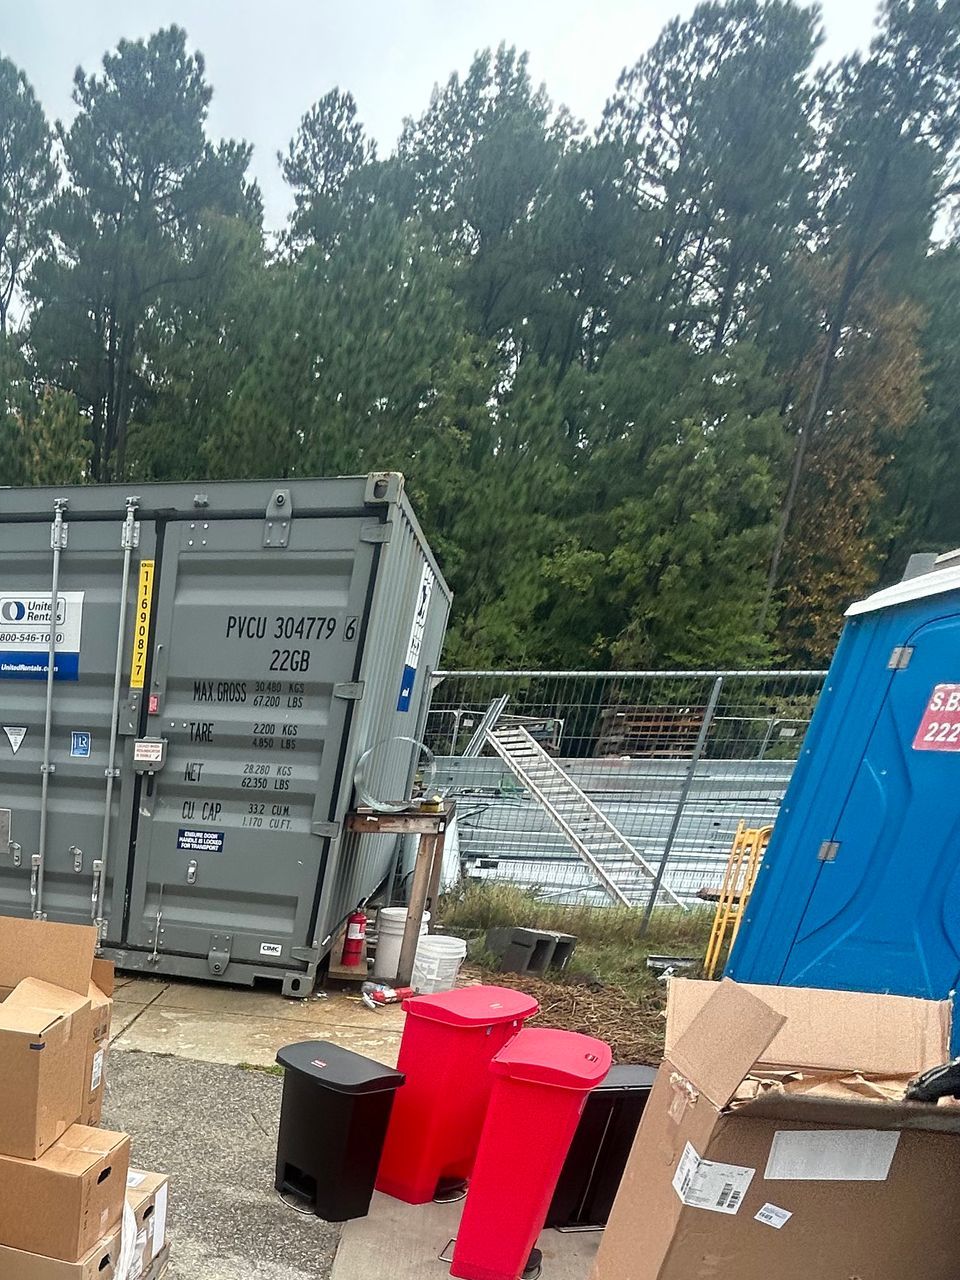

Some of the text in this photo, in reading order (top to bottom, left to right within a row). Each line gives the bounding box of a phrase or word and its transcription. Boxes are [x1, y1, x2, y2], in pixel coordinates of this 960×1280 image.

[226, 616, 357, 641] PVCU 304779 6
[0, 633, 62, 642] 800-546-100
[269, 650, 311, 672] 22GB
[0, 664, 58, 672] UnitedRentals.cm
[289, 683, 305, 694] KGS
[253, 695, 304, 708] 67.200 LBS
[190, 722, 298, 742] TARE 2.200 KGS
[281, 739, 296, 750] LBS
[184, 762, 204, 782] NET
[276, 766, 293, 777] KGS
[241, 777, 290, 791] 62.350 LBS
